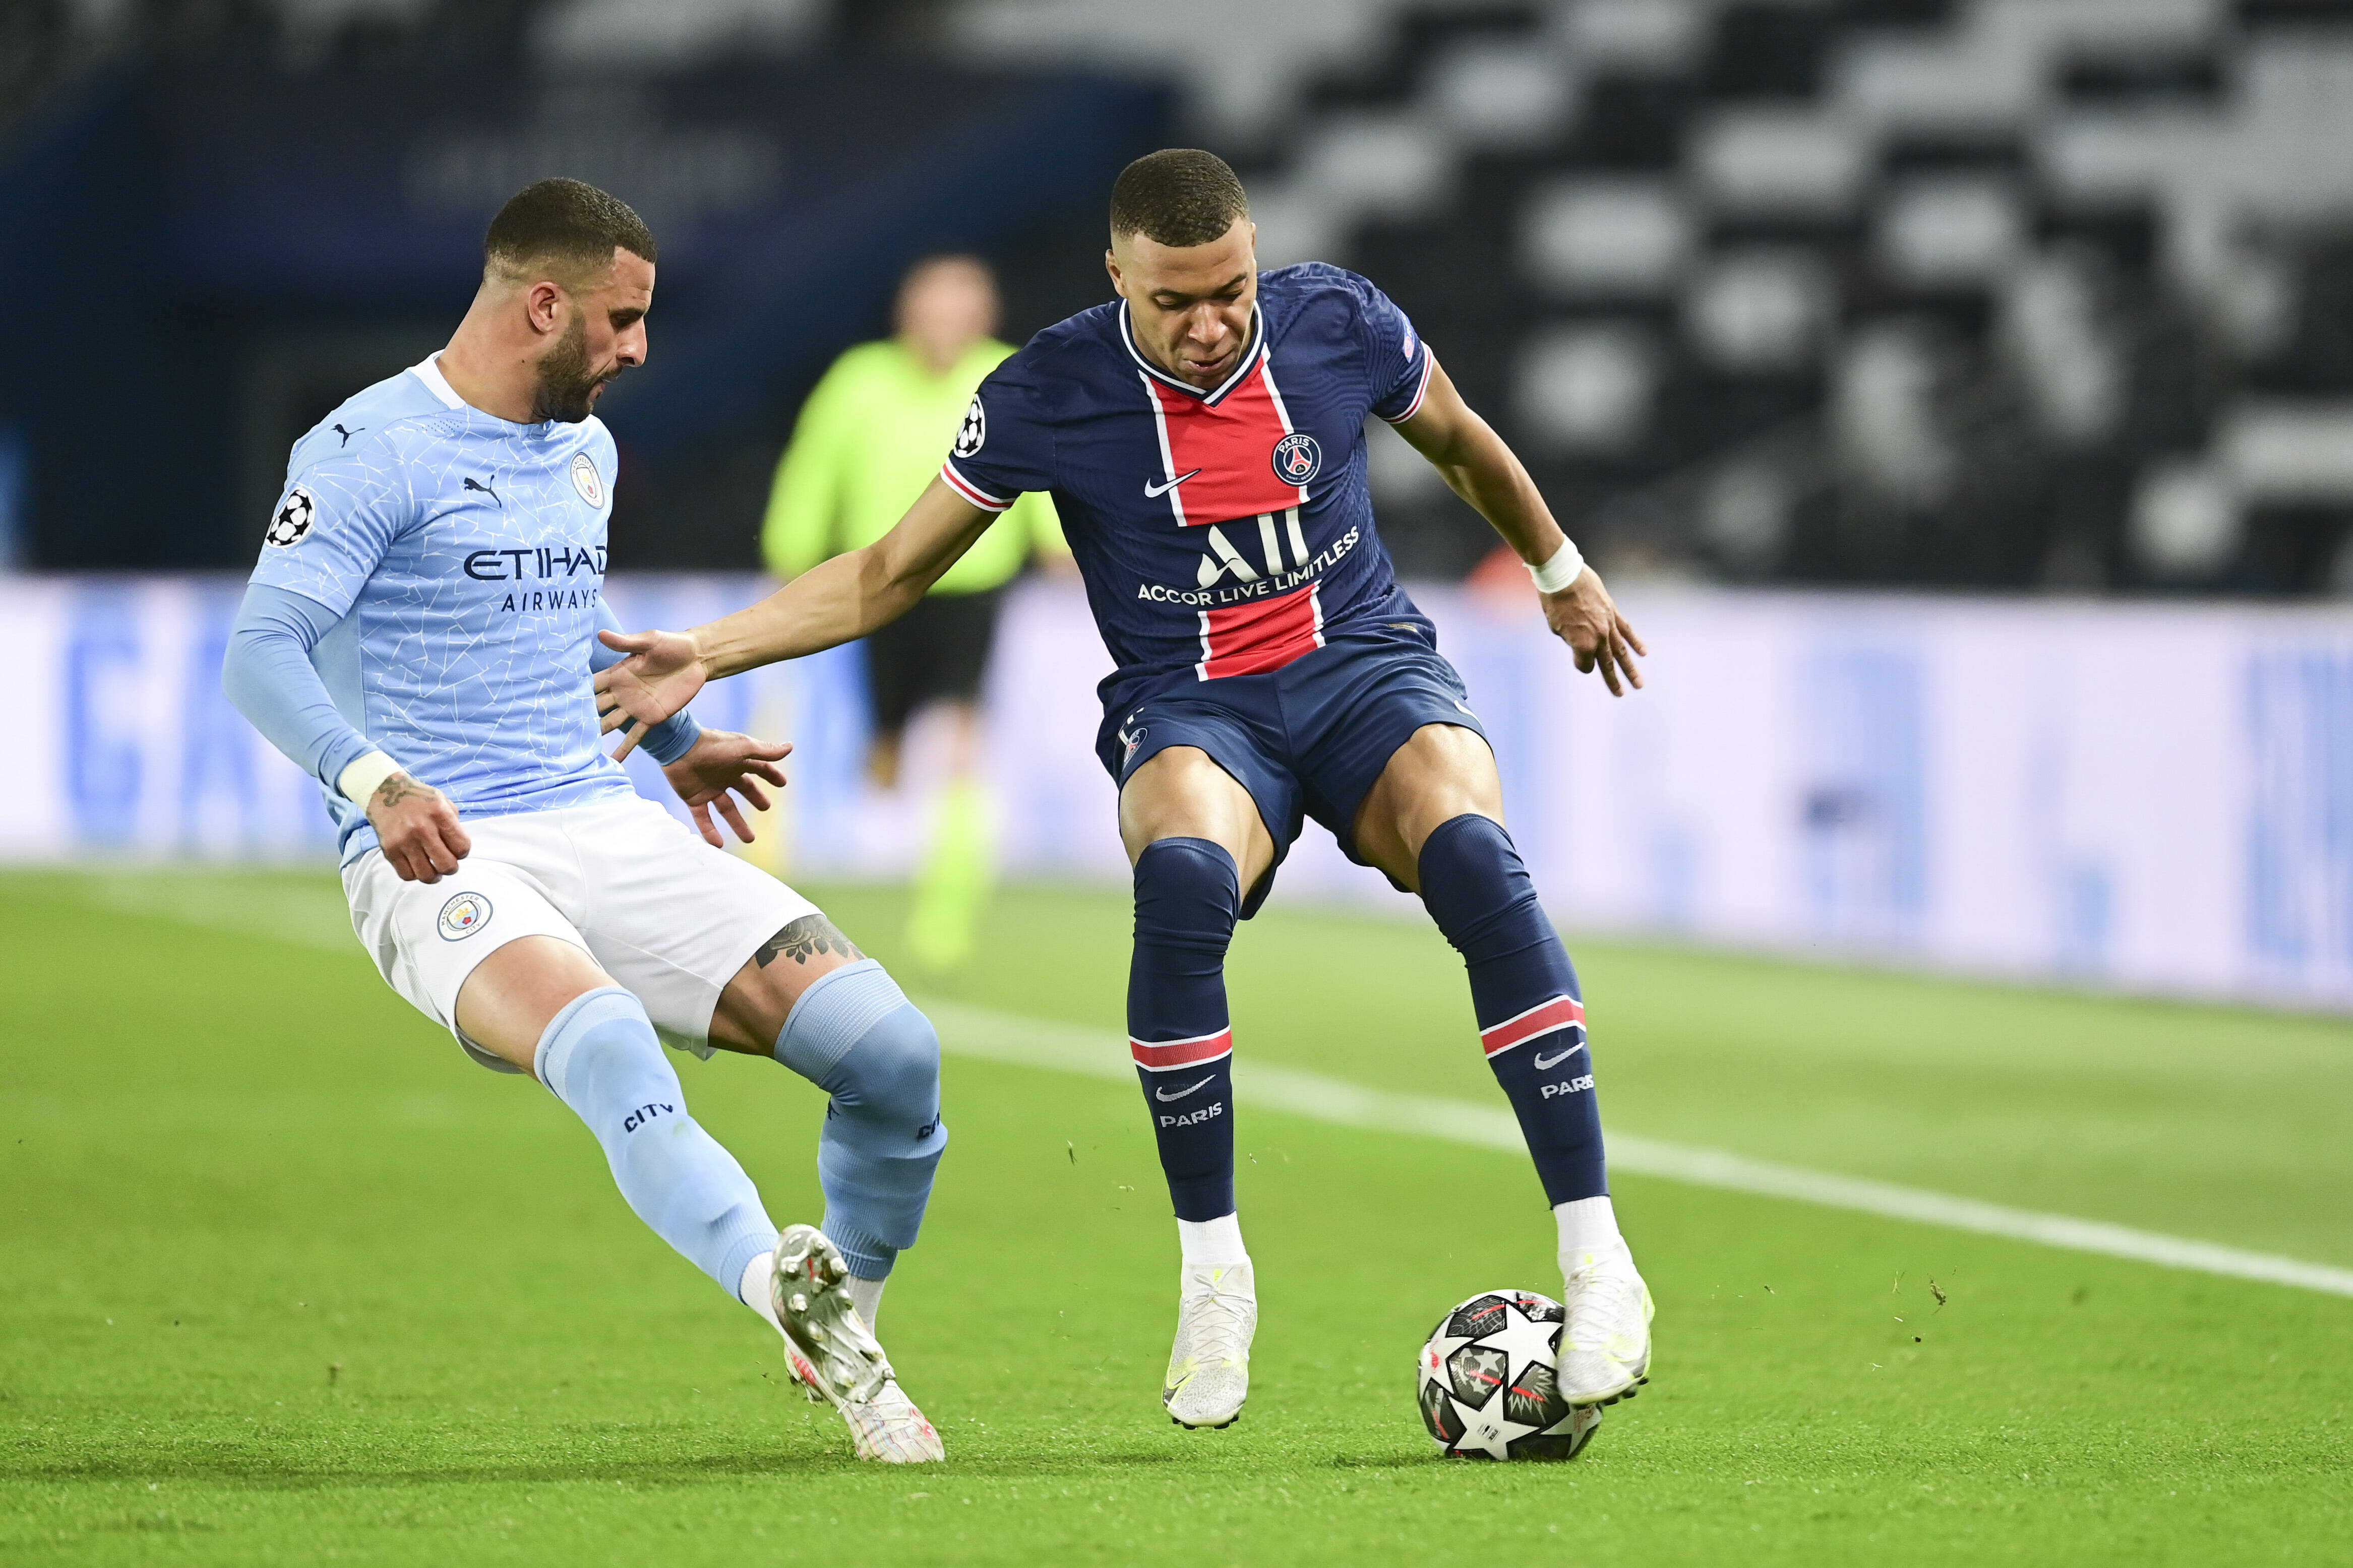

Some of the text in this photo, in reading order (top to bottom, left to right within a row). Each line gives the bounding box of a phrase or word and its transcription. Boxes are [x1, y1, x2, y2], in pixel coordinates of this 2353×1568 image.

[1278, 437, 1310, 453] PARIS
[1137, 526, 1359, 605] ACCOR LIVE LIMITLESS
[501, 589, 597, 612] AIRWAYS
[441, 895, 479, 926] MANCHESTER
[465, 922, 481, 934] CITY
[1160, 1102, 1222, 1127] PARIS
